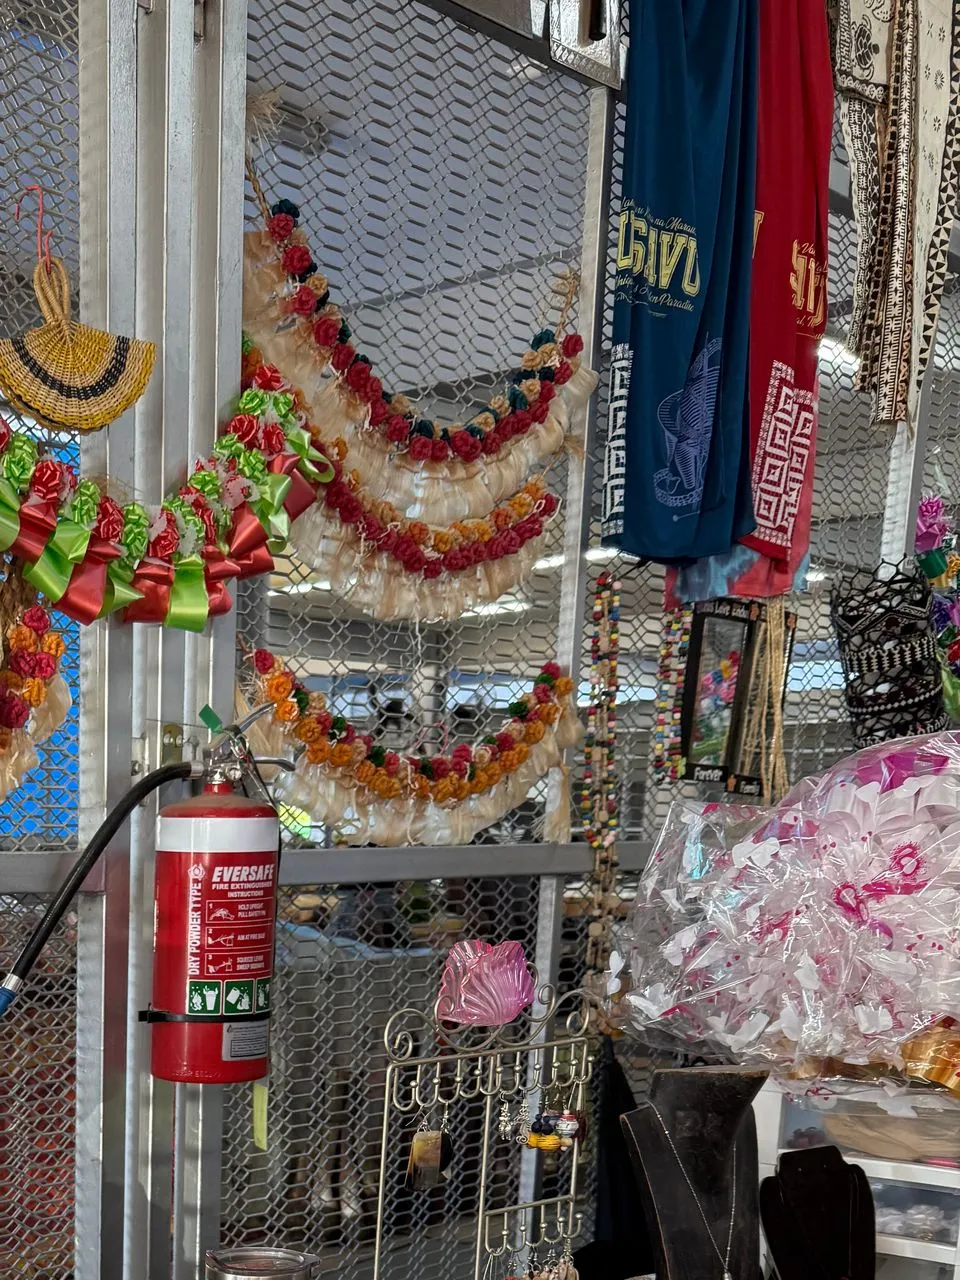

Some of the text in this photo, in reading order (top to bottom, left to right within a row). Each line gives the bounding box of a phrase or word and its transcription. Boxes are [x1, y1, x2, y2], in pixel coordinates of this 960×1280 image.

[693, 766, 723, 781] Forever
[211, 882, 230, 890] FIRE
[188, 882, 202, 975] DRY POWDER TYPE
